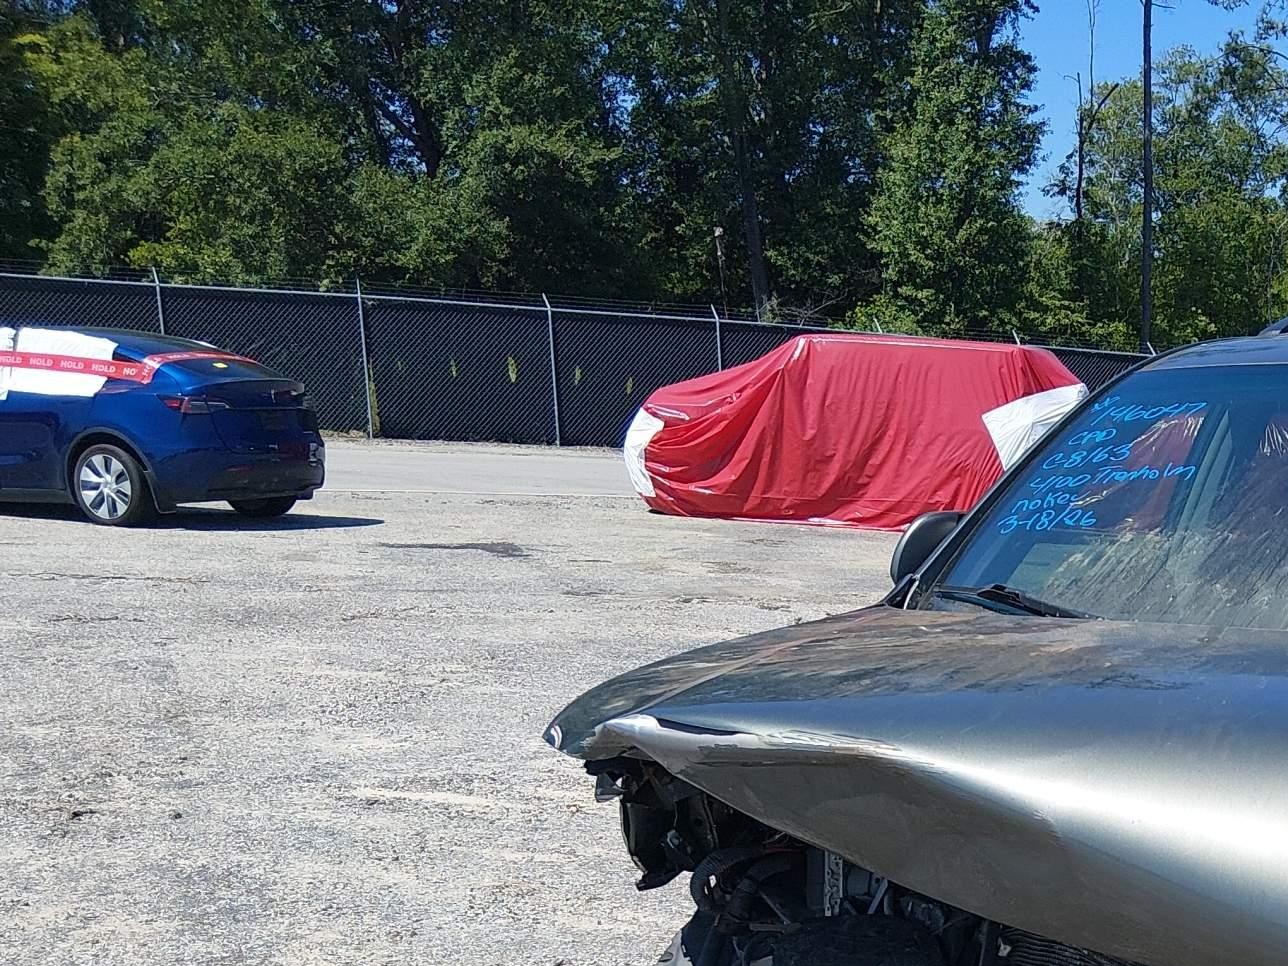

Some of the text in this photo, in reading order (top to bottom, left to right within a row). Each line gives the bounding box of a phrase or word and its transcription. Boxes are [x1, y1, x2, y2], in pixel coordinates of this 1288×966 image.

[30, 357, 53, 367] HOLD
[60, 360, 84, 370] HOLD
[91, 363, 116, 373] HOLD
